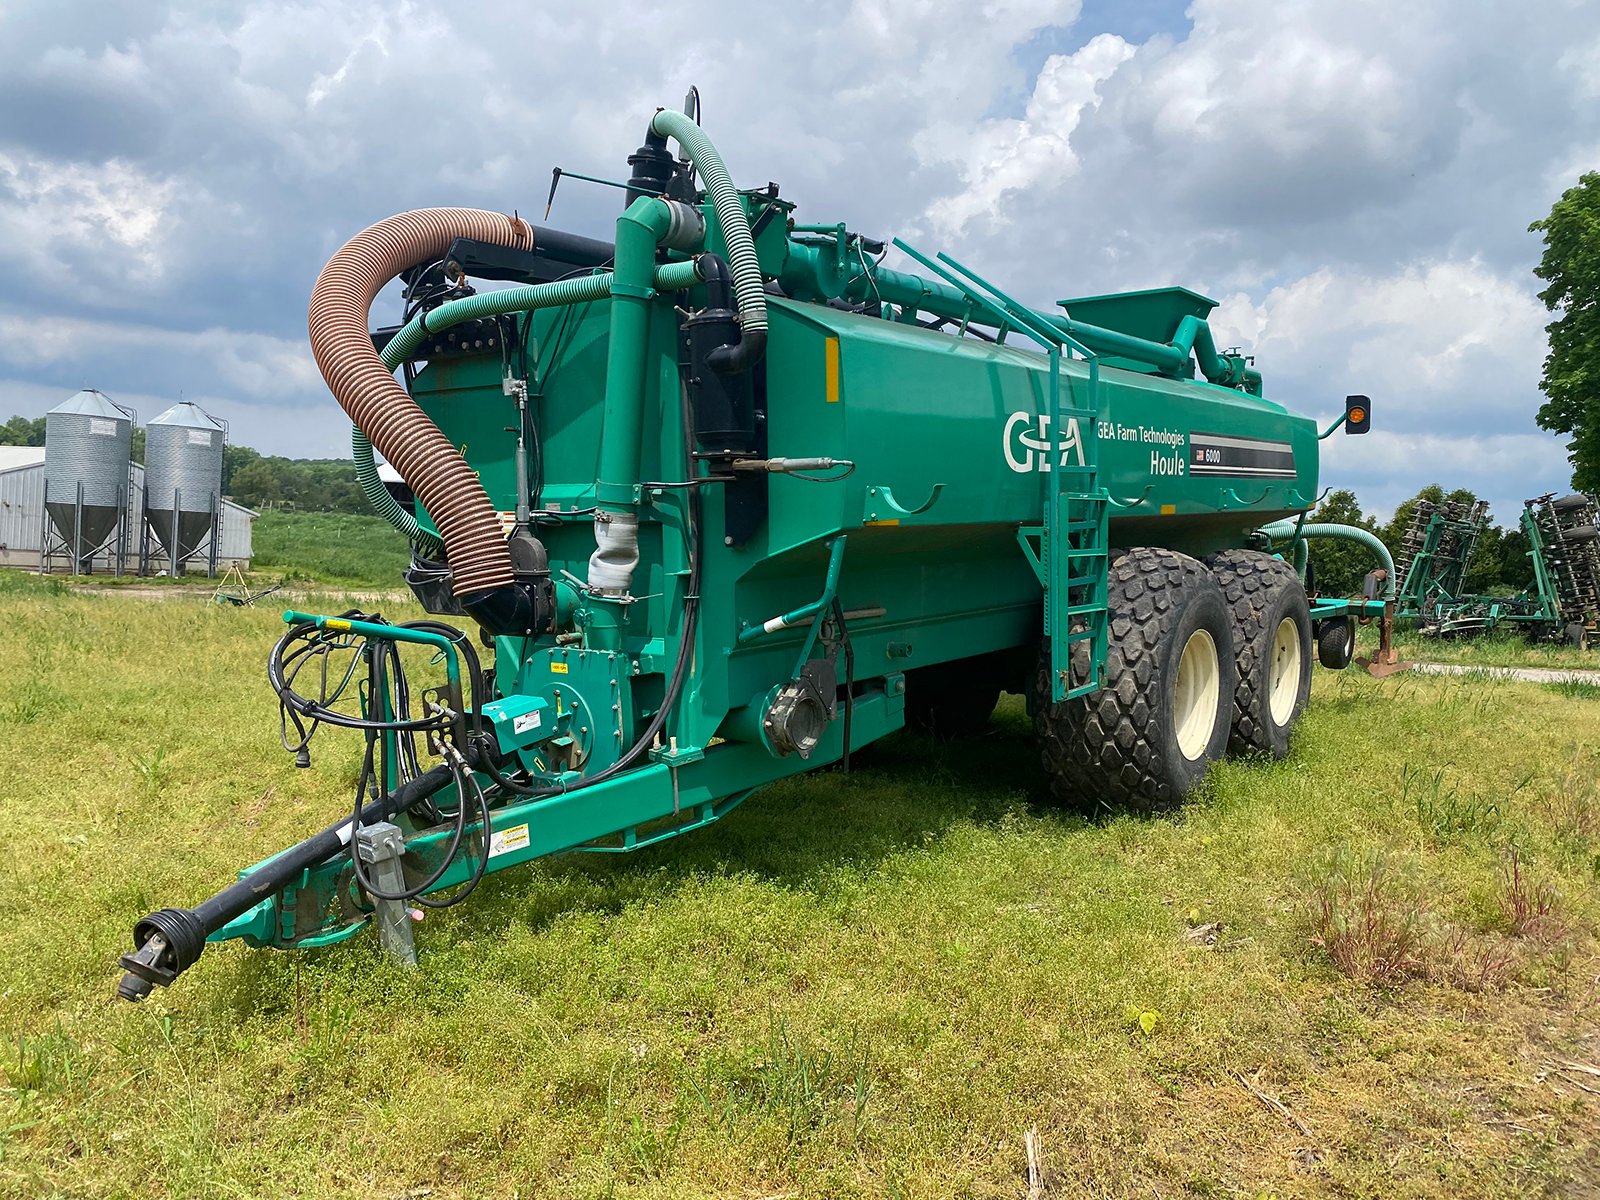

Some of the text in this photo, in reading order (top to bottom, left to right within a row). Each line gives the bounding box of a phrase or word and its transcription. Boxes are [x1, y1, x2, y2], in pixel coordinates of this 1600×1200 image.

[1097, 421, 1185, 449] GEA Farm Technologies
[1150, 450, 1185, 476] Houle
[1205, 448, 1221, 464] 6000
